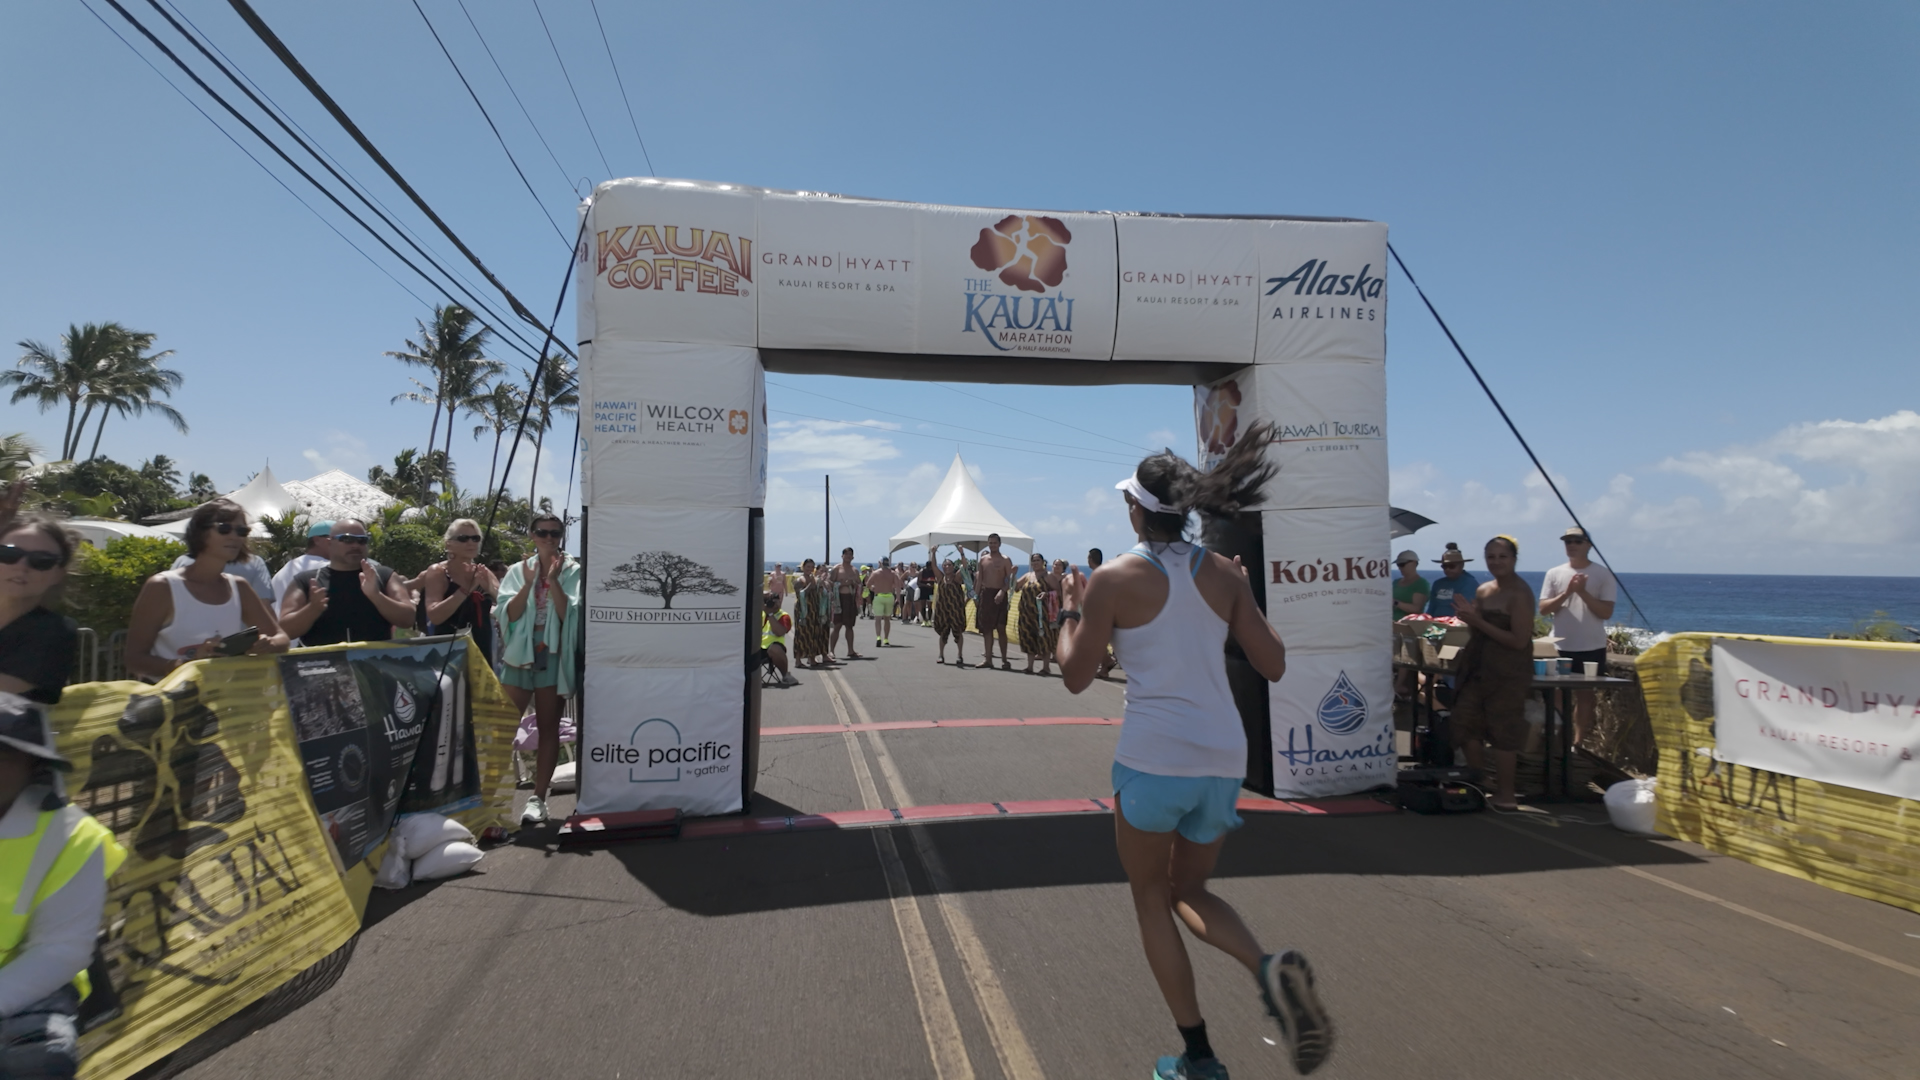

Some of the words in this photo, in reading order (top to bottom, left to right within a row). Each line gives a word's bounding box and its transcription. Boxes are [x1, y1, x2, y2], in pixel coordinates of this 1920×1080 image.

[596, 225, 753, 283] KAUAI
[762, 252, 832, 268] GRAND
[846, 256, 912, 273] HYATT
[607, 257, 740, 296] COFFEE
[1122, 271, 1185, 285] GRAND
[1198, 273, 1254, 287] HYATT
[1264, 258, 1383, 303] Alaska
[778, 279, 812, 288] KAUAI
[817, 281, 860, 291] RESORT
[876, 284, 896, 293] SPA
[964, 278, 992, 292] THE
[1136, 296, 1167, 304] KAUAI
[1171, 296, 1209, 306] RESORT
[1213, 298, 1219, 306] &
[1223, 299, 1239, 307] SPA
[962, 290, 1075, 351] KAUA'I
[1271, 306, 1376, 321] AIRLINES
[999, 331, 1073, 344] MARATHON
[594, 401, 637, 411] HAWAI'I
[647, 404, 725, 421] WILCOX
[594, 412, 637, 422] PACIFIC
[594, 423, 636, 433] HEALTH
[656, 421, 714, 433] HEALTH
[1333, 421, 1381, 437] TOURISM
[1305, 444, 1360, 452] AUTHORITY
[1269, 557, 1339, 585] Ko'a
[1343, 556, 1390, 581] Kea
[1283, 591, 1318, 604] RESORT
[590, 609, 623, 621] POIPU
[626, 609, 691, 622] SHOPPING
[694, 609, 741, 622] VILLAGE
[1735, 678, 1839, 708] GRAND
[1278, 724, 1396, 766] Hawai'i
[1817, 733, 1889, 757] RESORT
[1900, 747, 1912, 760] &
[590, 743, 640, 764] elite
[648, 741, 731, 768] pacific
[694, 763, 730, 777] gather
[1290, 757, 1393, 776] VOLCANIC
